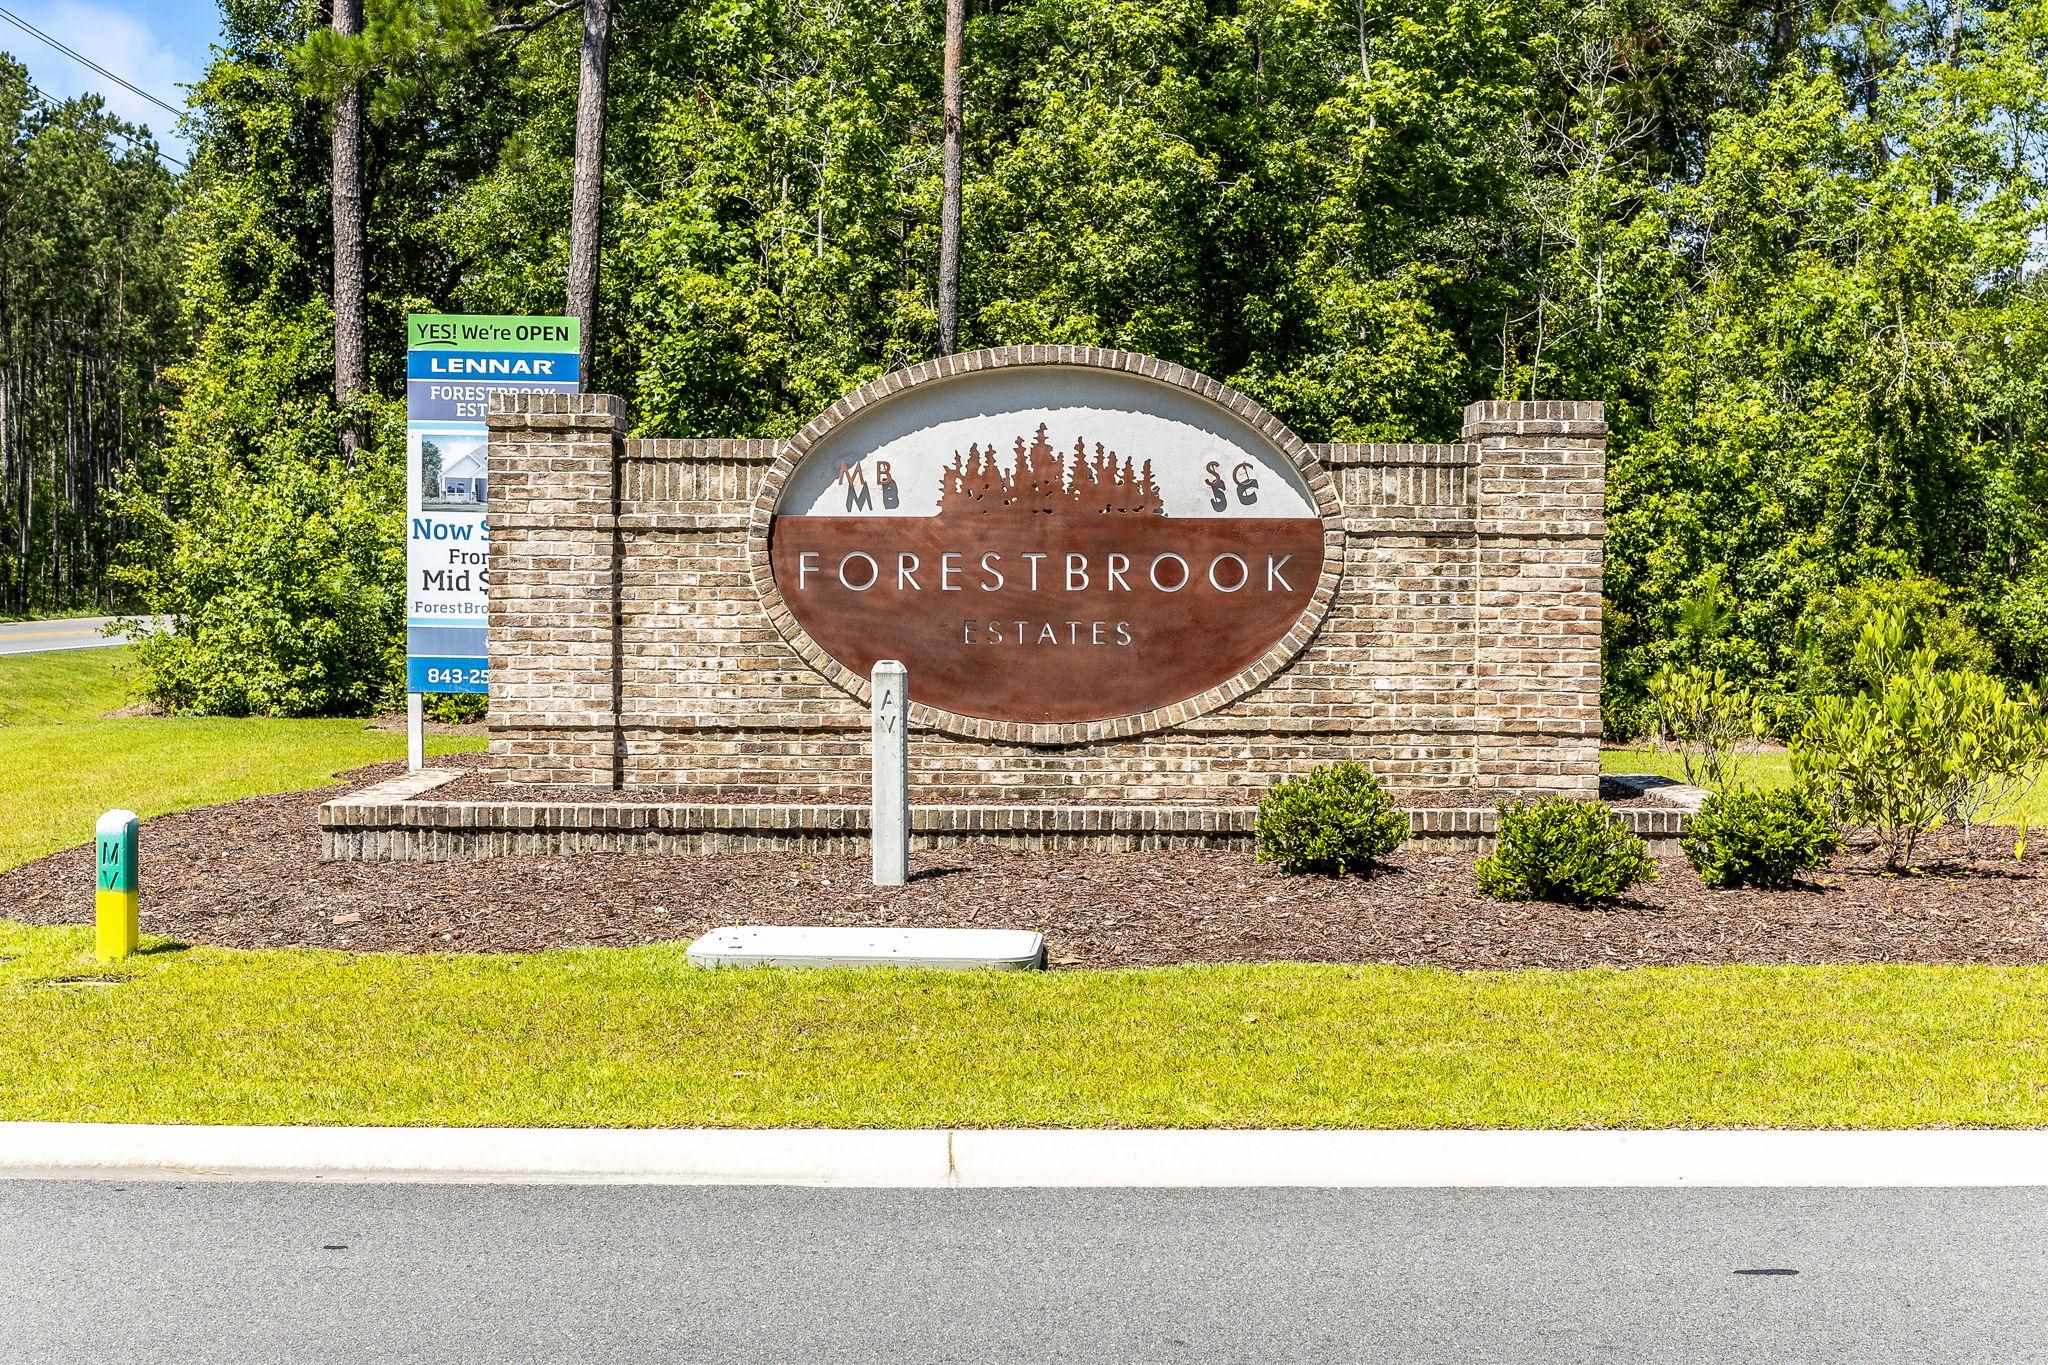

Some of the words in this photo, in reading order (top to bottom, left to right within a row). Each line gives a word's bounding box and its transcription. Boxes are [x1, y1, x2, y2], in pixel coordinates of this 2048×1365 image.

[416, 323, 457, 339] YES!
[462, 325, 511, 340] We're
[515, 326, 569, 341] OPEN
[431, 358, 553, 374] LENNAR
[412, 518, 473, 540] Now
[422, 569, 471, 592] Mid
[799, 552, 1294, 592] FORESTBROOK
[964, 620, 1132, 645] ESTATES
